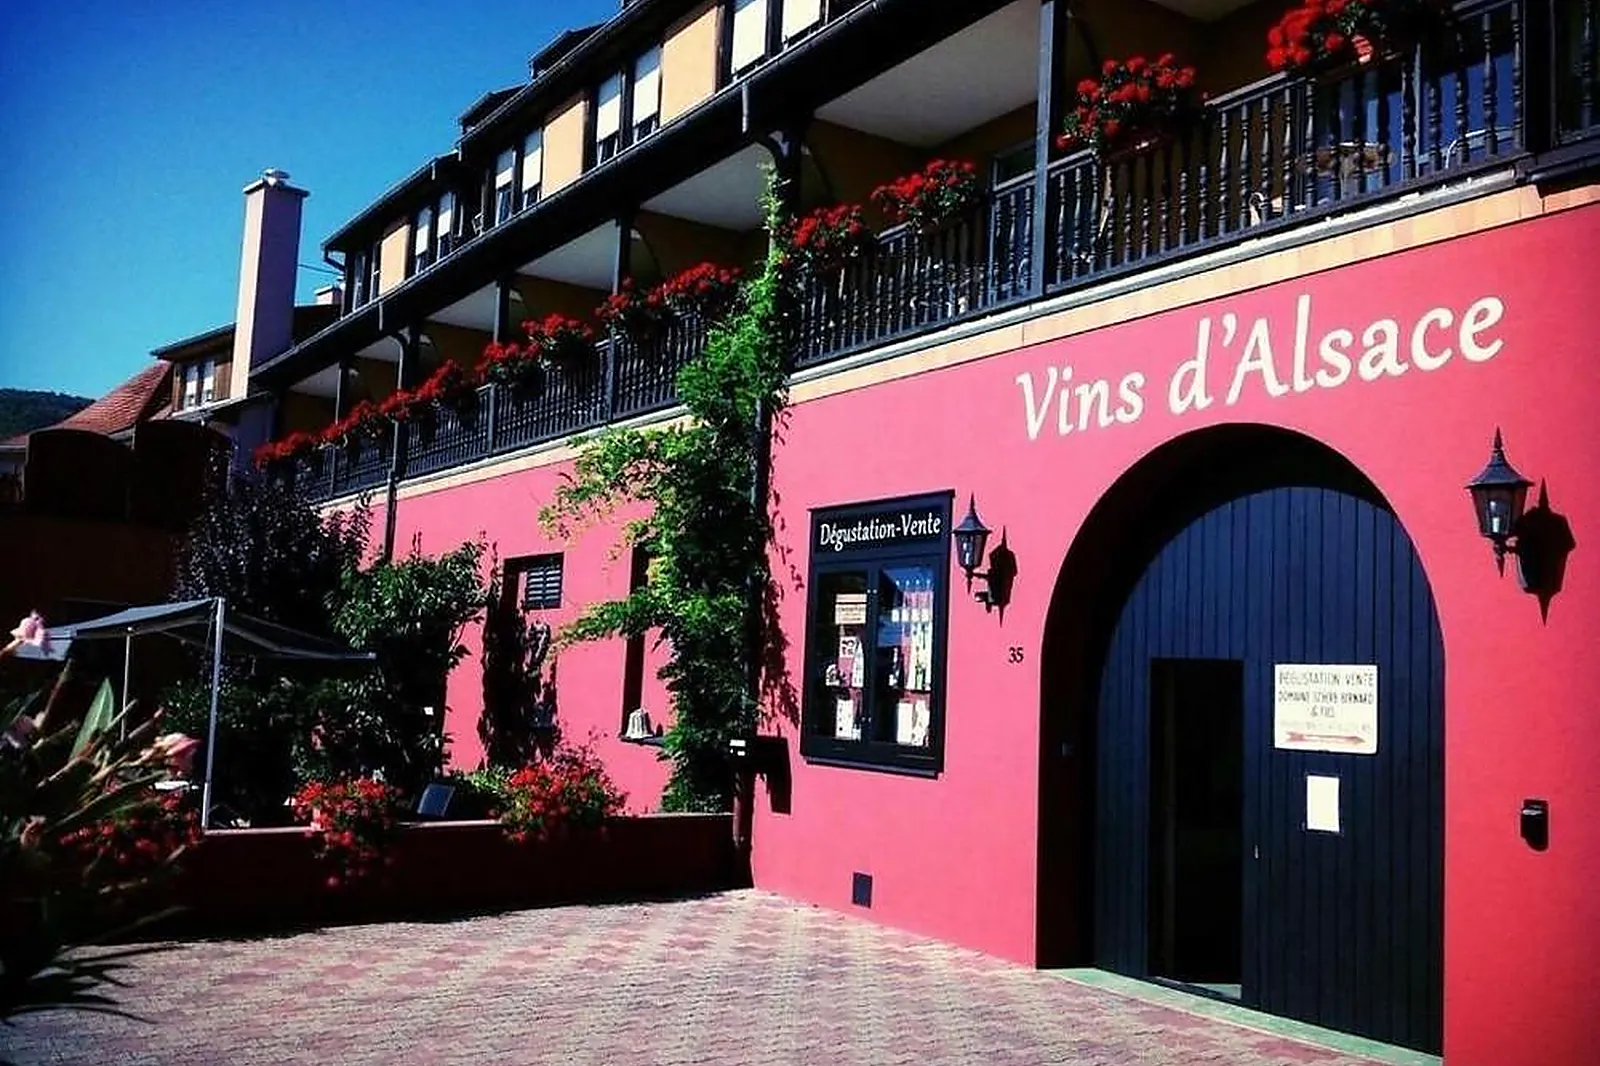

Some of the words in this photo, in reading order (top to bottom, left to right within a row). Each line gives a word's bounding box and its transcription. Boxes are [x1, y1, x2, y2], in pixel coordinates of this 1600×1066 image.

[1015, 363, 1146, 441] Vins
[1168, 294, 1505, 415] d'Alsace
[820, 512, 941, 552] Dégustation-Vente
[1008, 646, 1024, 664] 35
